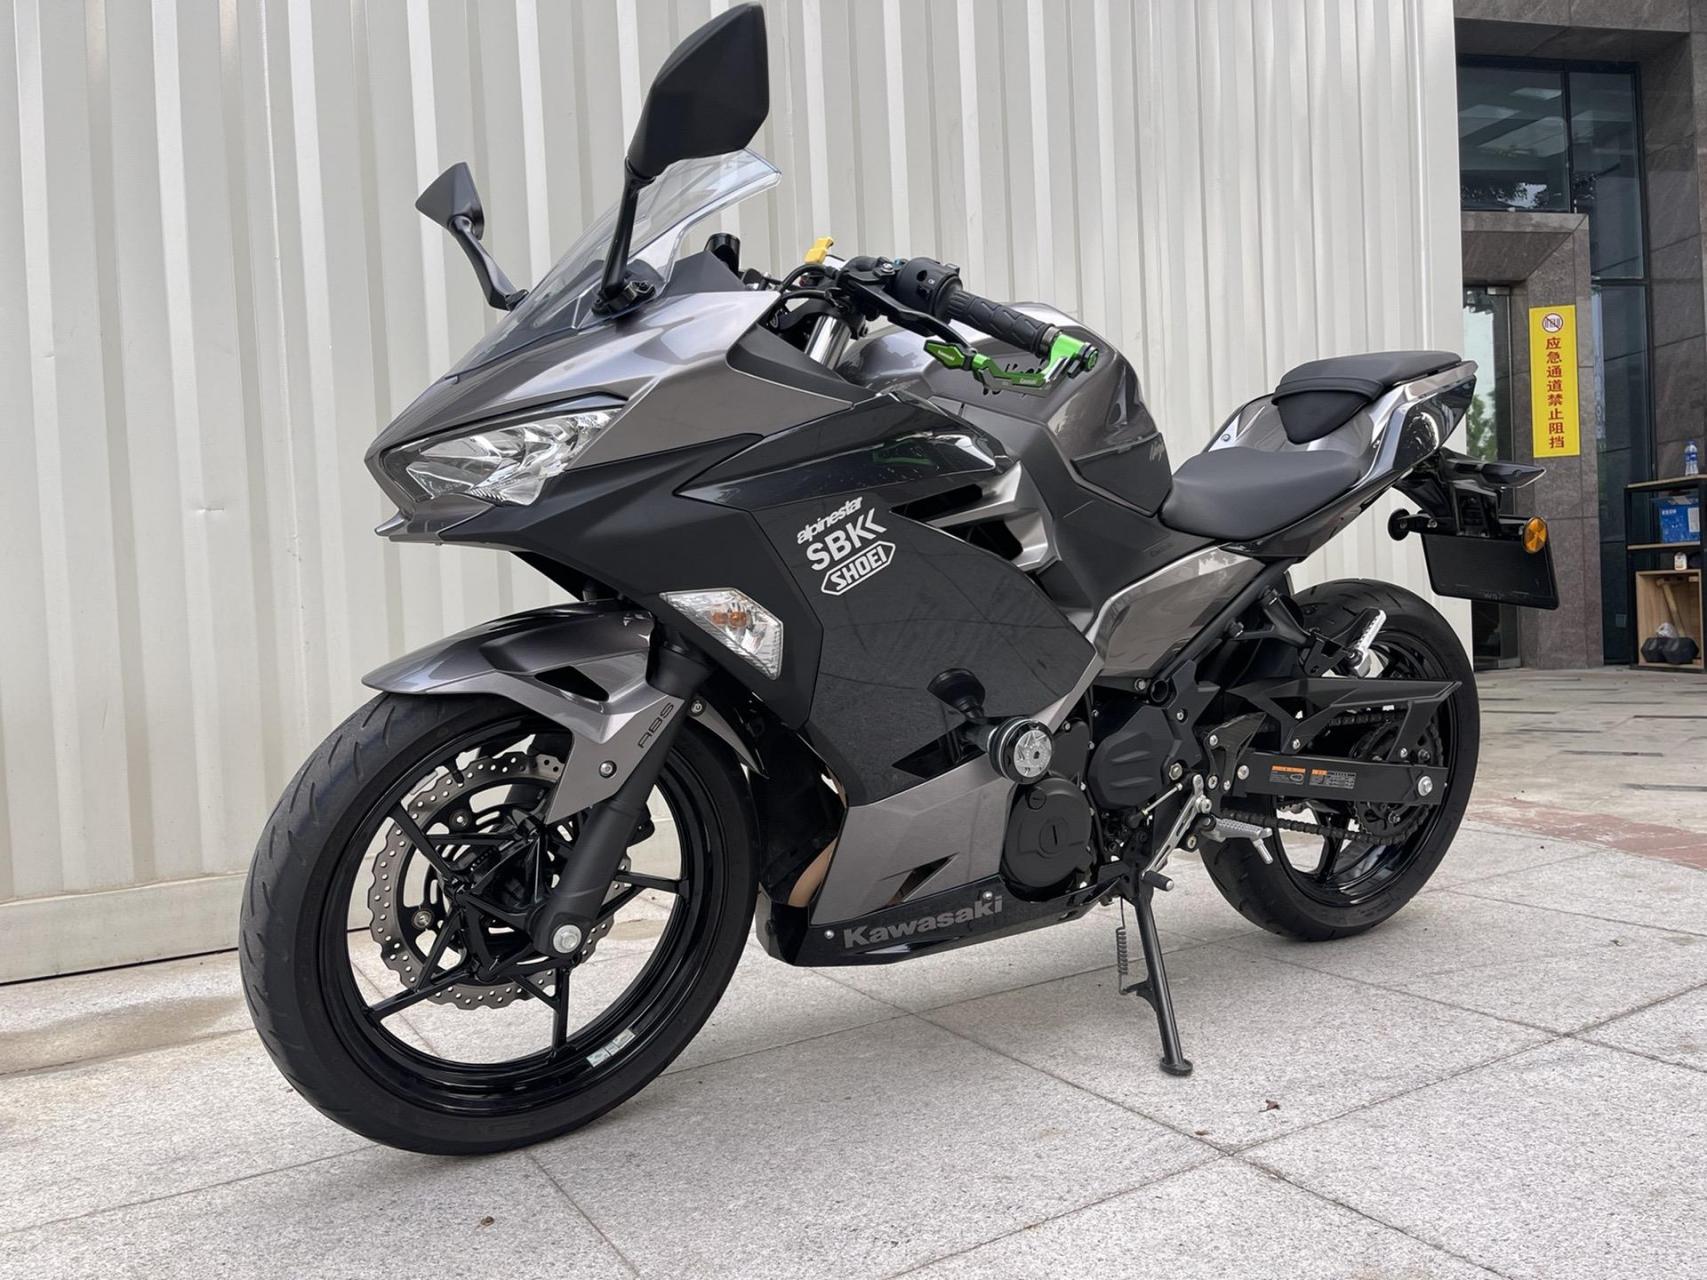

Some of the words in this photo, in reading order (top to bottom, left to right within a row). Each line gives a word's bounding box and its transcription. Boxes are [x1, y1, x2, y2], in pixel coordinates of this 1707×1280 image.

[1545, 337, 1565, 449] 应急通道禁止阻挡
[806, 507, 888, 571] SBK
[830, 545, 888, 591] SHOEI
[638, 702, 674, 748] ABS
[843, 895, 1003, 949] Kawasaki
